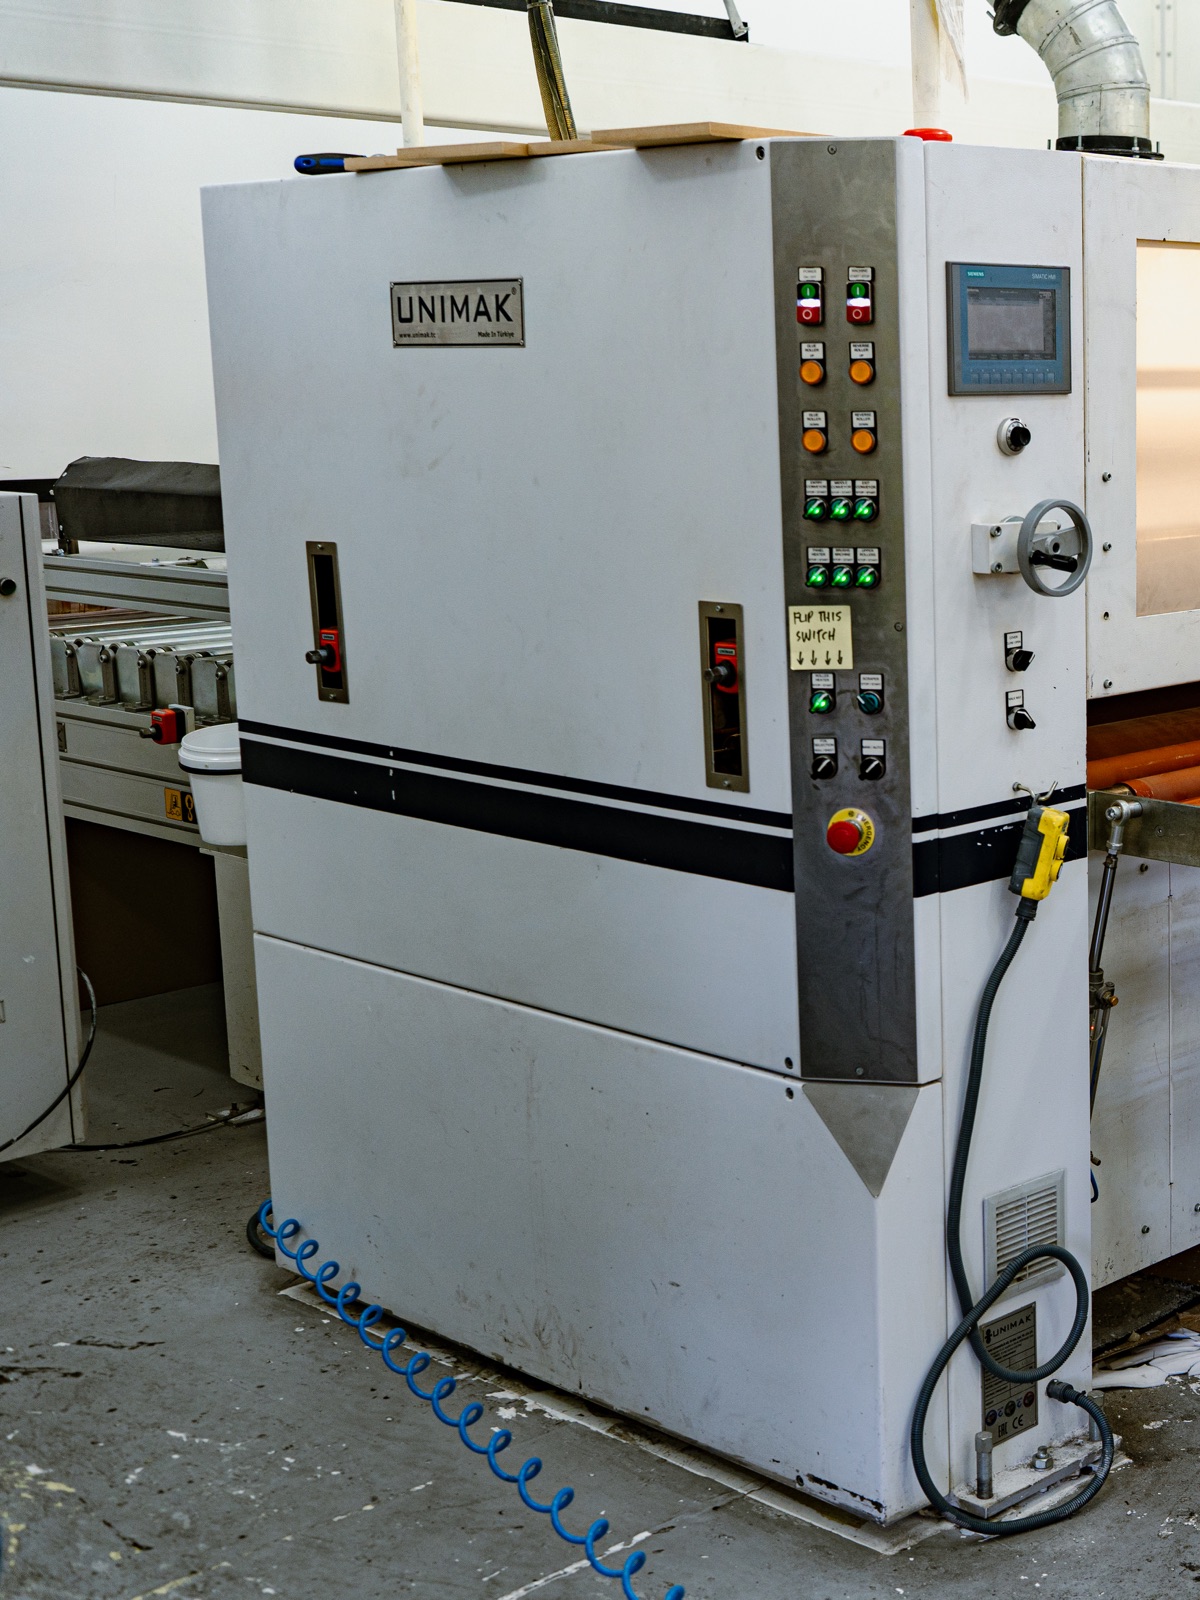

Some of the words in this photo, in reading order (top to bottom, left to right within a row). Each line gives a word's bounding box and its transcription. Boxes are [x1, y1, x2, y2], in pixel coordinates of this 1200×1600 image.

[397, 294, 513, 323] UNIMAK
[793, 611, 814, 624] FLIP
[818, 611, 842, 622] THIS
[796, 627, 836, 643] SWITCH
[993, 1315, 1031, 1337] UNIMAK
